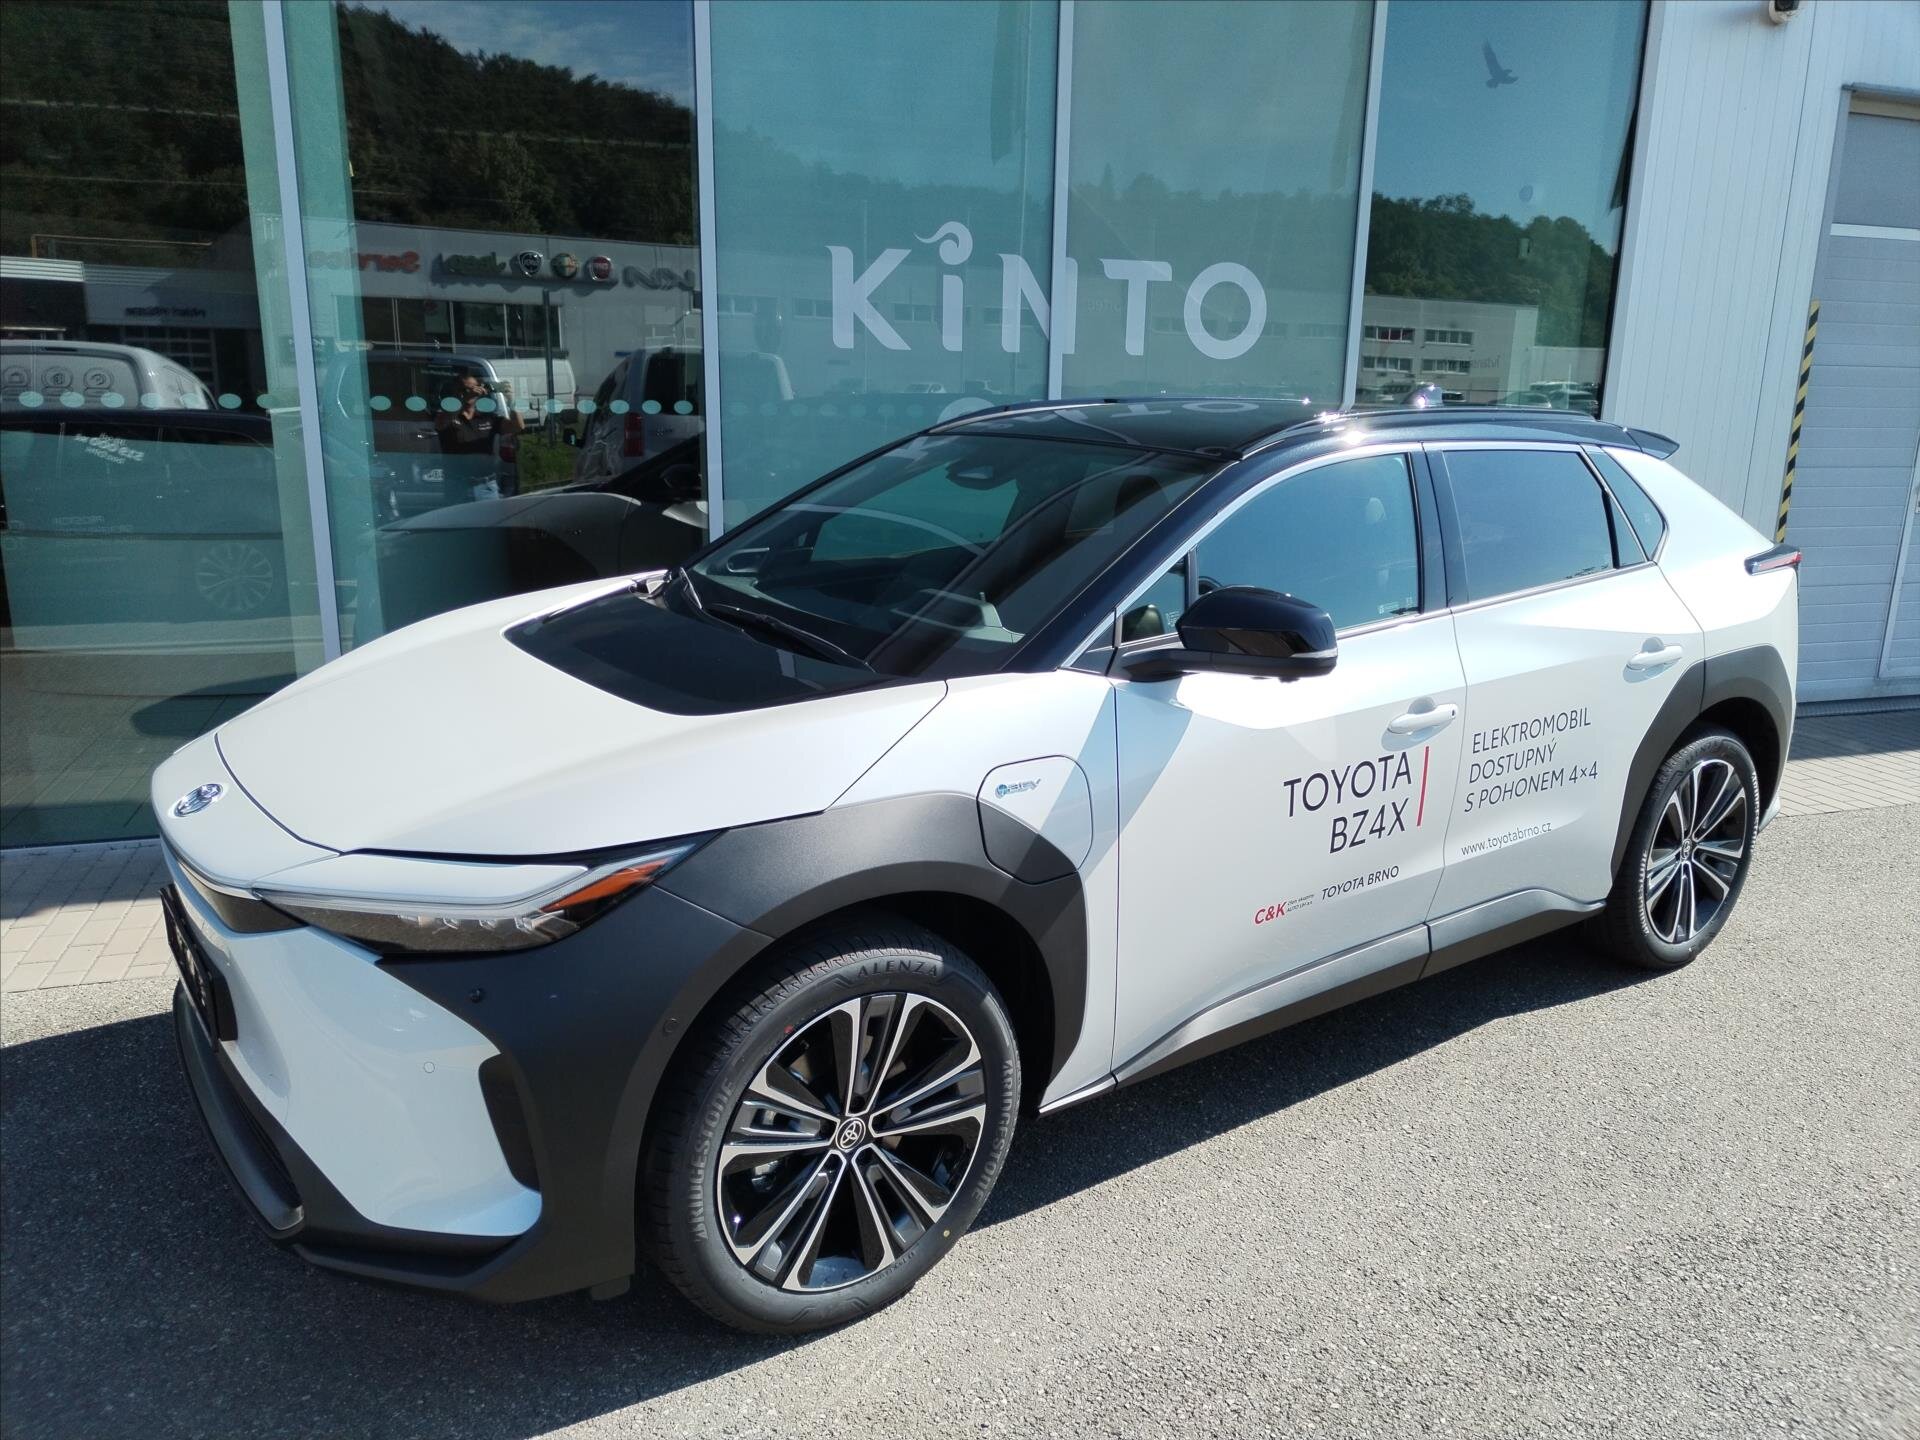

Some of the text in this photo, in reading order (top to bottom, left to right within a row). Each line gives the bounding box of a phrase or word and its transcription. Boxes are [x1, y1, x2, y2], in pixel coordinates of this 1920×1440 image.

[1472, 707, 1592, 754] ELEKTROMOBIL
[1469, 737, 1557, 784] DOSTUPNÝ
[1283, 751, 1412, 818] TOYOTA
[1464, 792, 1475, 813] S
[1478, 767, 1565, 809] POHONEM
[1329, 797, 1409, 854] BZ4X
[1461, 822, 1552, 856] www.toyotabrno.cz
[1322, 876, 1365, 900] TOYOTA
[1367, 865, 1400, 886] BRNO
[1254, 901, 1287, 925] C&K
[858, 960, 938, 977] ALENZA
